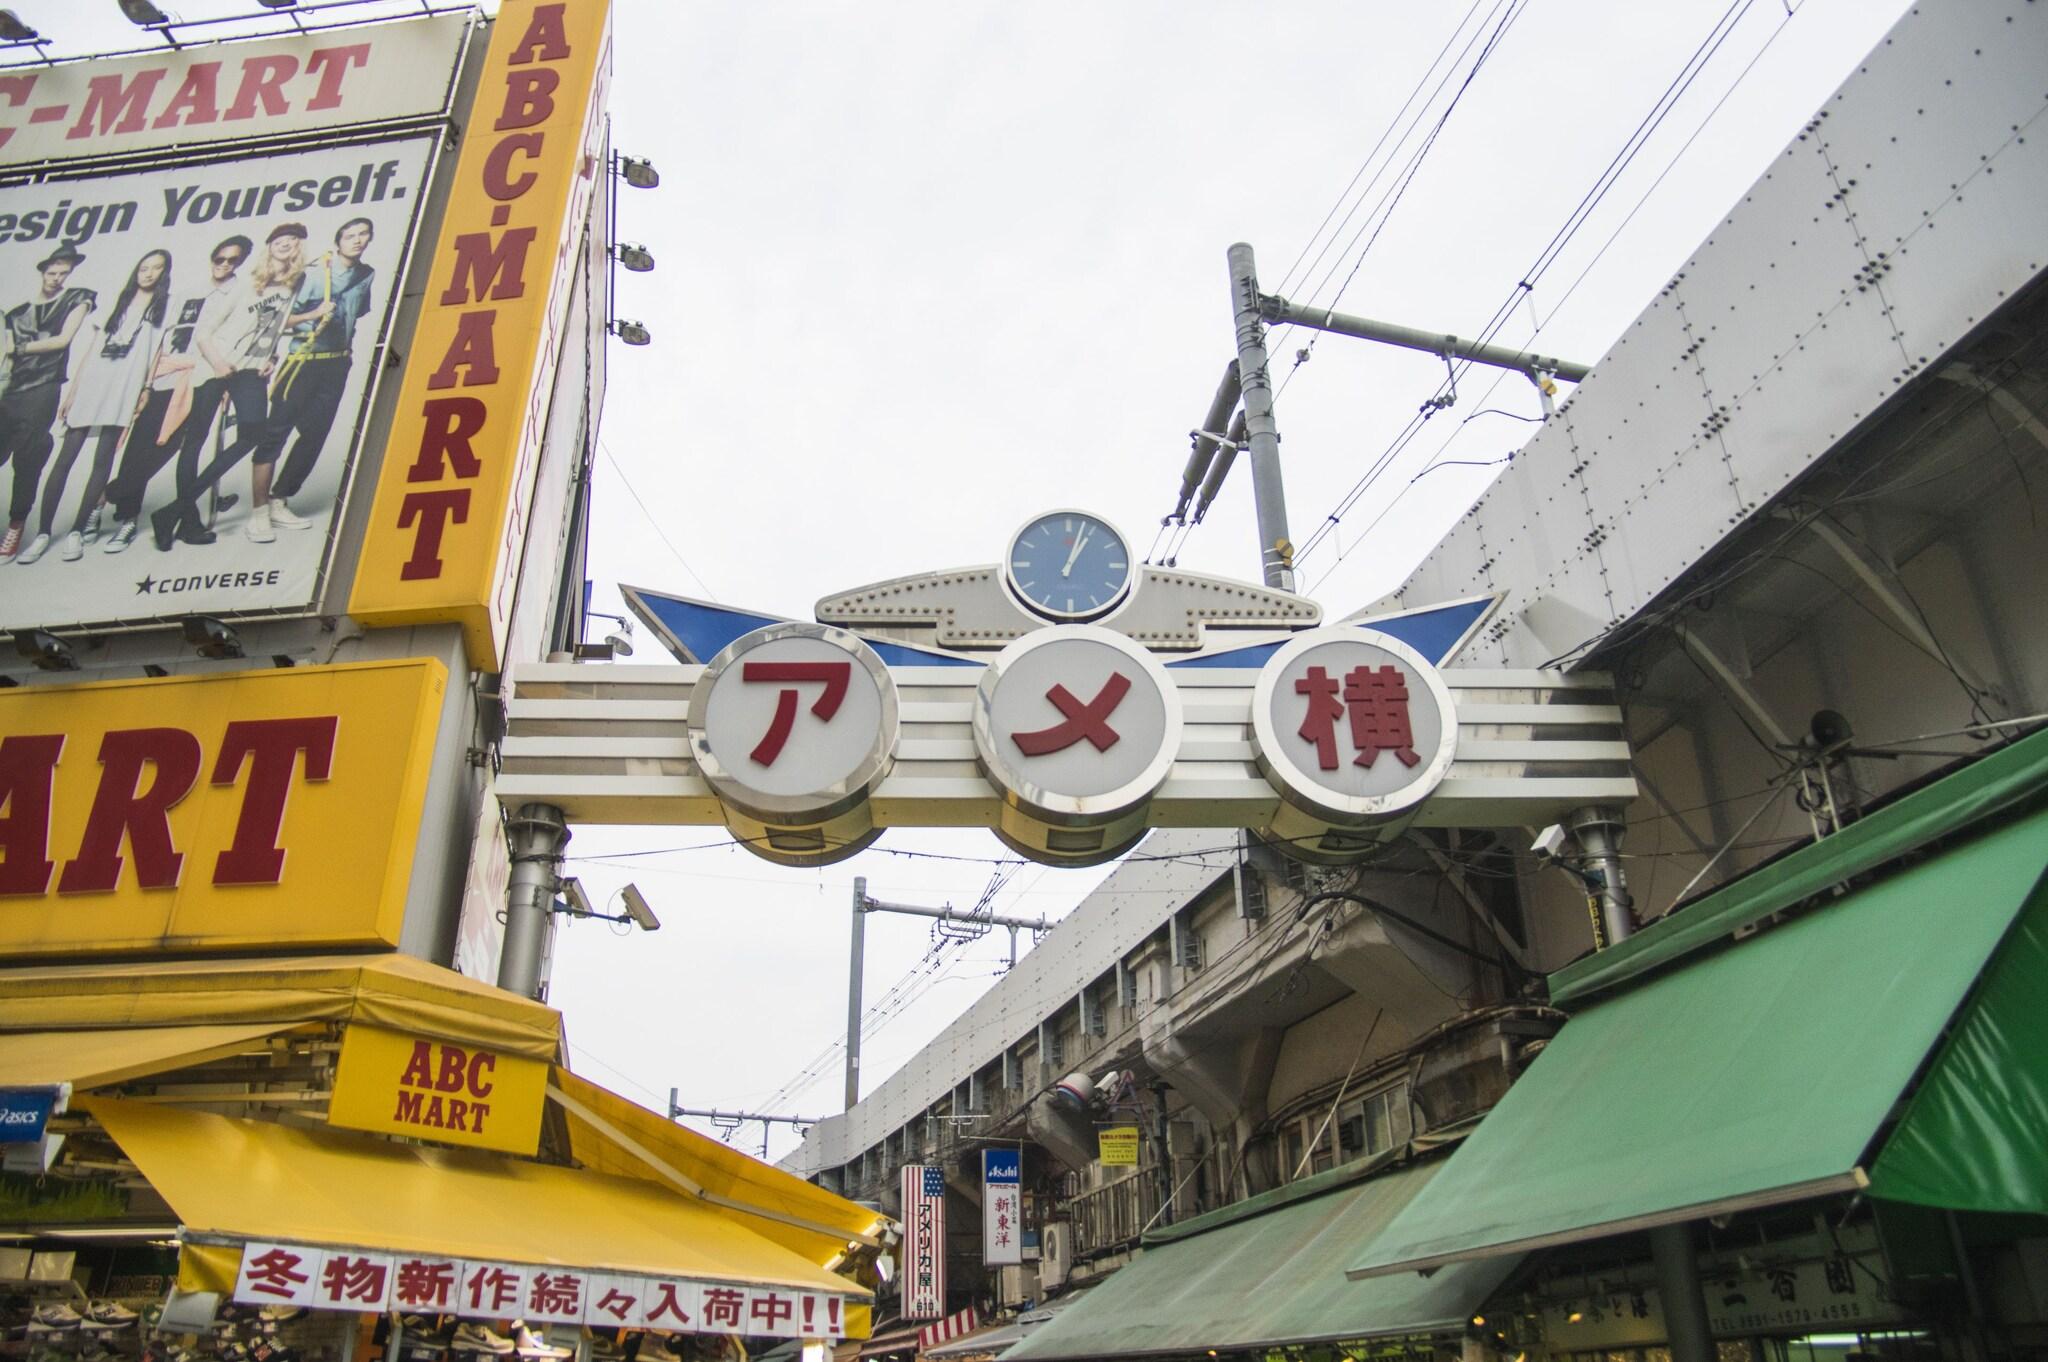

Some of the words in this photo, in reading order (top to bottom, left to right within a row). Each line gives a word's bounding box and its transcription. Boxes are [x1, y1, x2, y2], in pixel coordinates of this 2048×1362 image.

[162, 160, 406, 227] Yourself.
[397, 3, 570, 580] ABC-MART
[158, 570, 280, 593] CONVERSE
[743, 663, 1421, 771] アメ横
[400, 1040, 496, 1098] ABC
[394, 1090, 490, 1133] MART
[988, 1165, 1018, 1177] Asahi
[918, 1204, 932, 1287] アメリカ屋
[995, 1197, 1011, 1248] 新東洋
